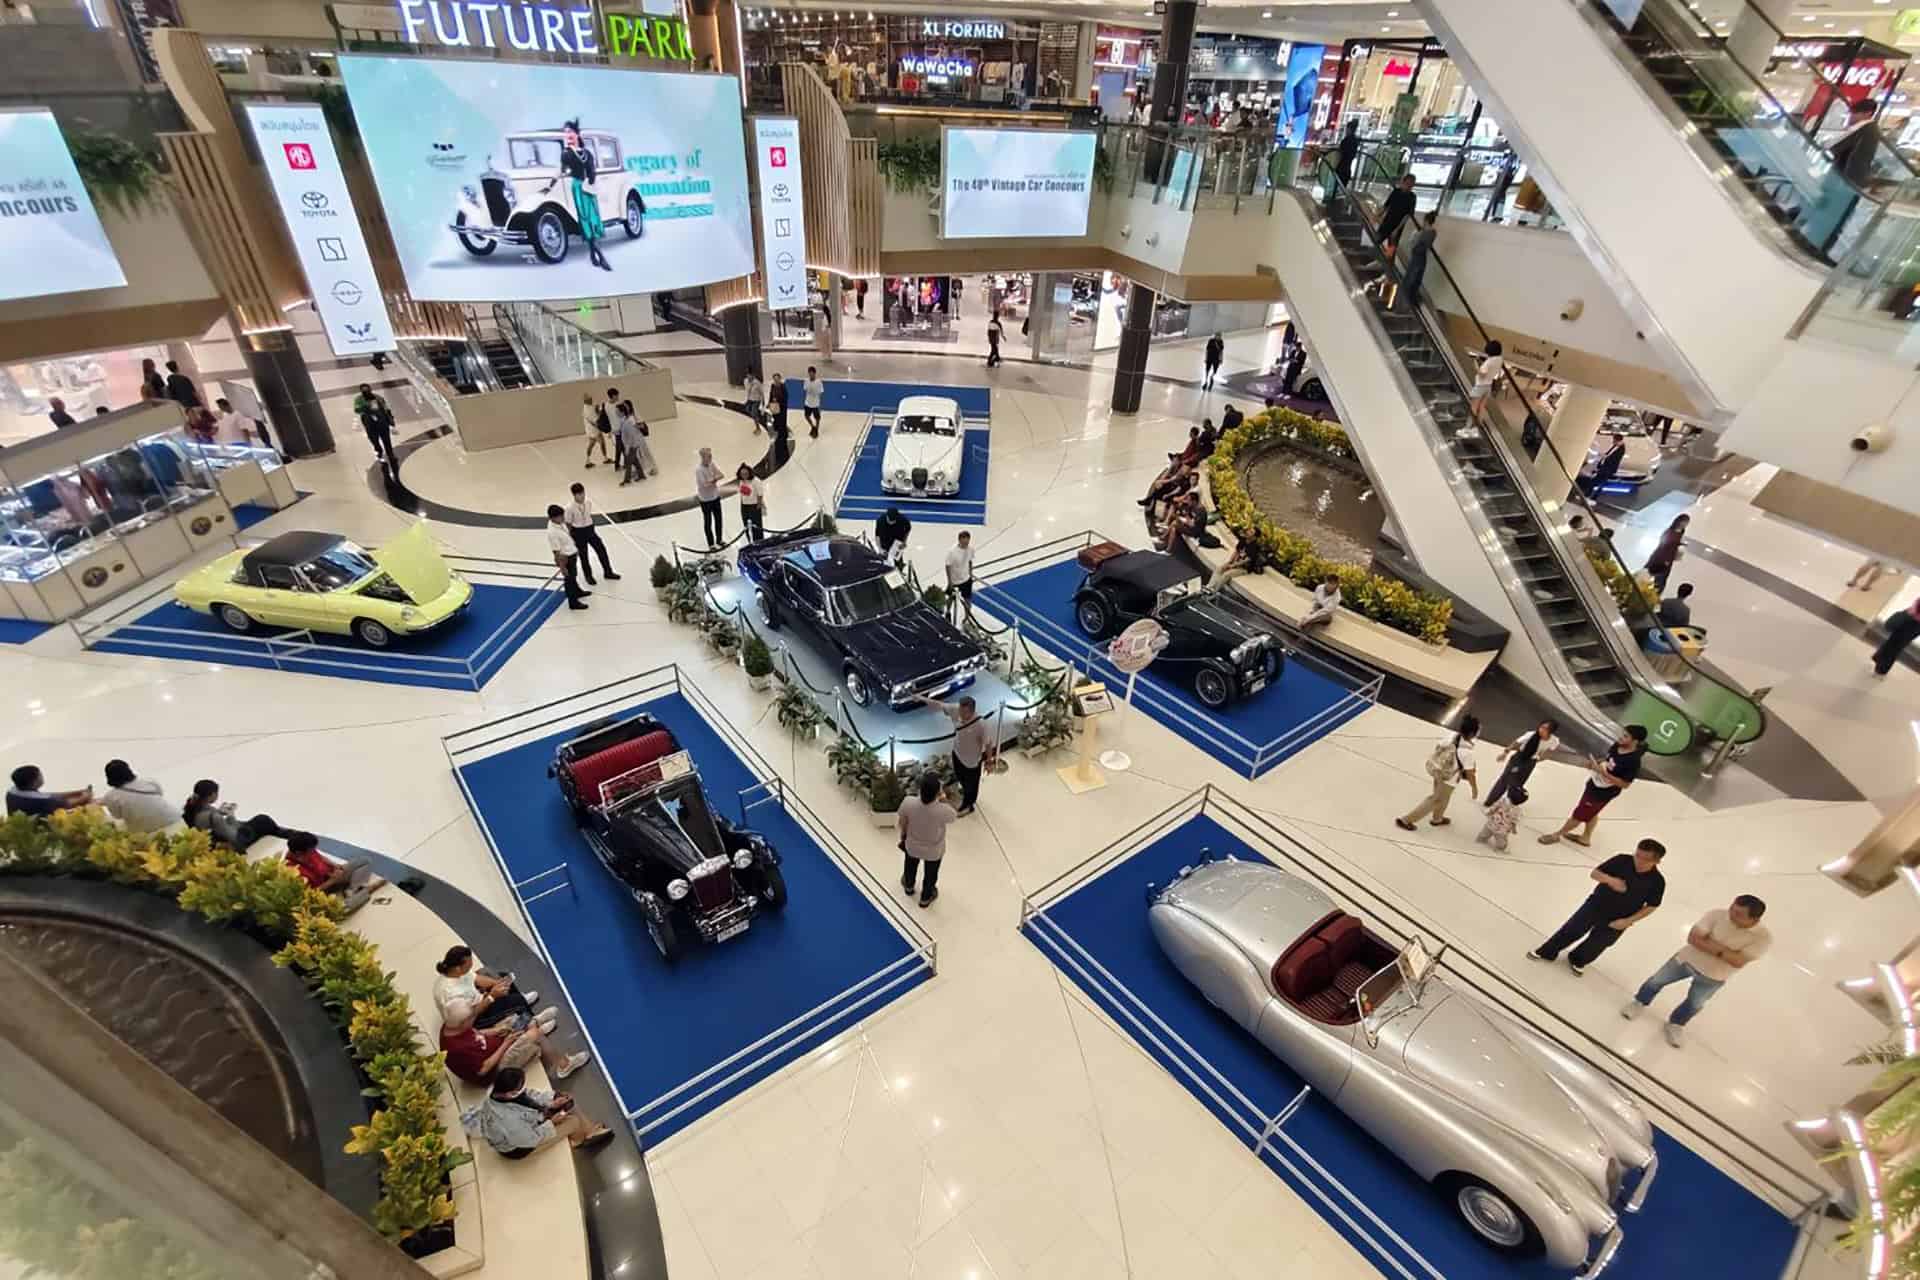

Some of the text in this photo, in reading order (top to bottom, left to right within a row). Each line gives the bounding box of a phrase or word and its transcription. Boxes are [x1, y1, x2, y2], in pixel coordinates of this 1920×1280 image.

[400, 0, 696, 60] FUTURE PARK
[923, 21, 1004, 38] XL FORMEN
[902, 58, 972, 76] WaWaCha
[1824, 64, 1880, 86] VNG
[953, 178, 970, 191] The
[991, 178, 1026, 192] Vintage
[1028, 179, 1043, 191] Car
[1045, 179, 1085, 192] Concours
[1660, 720, 1679, 737] G
